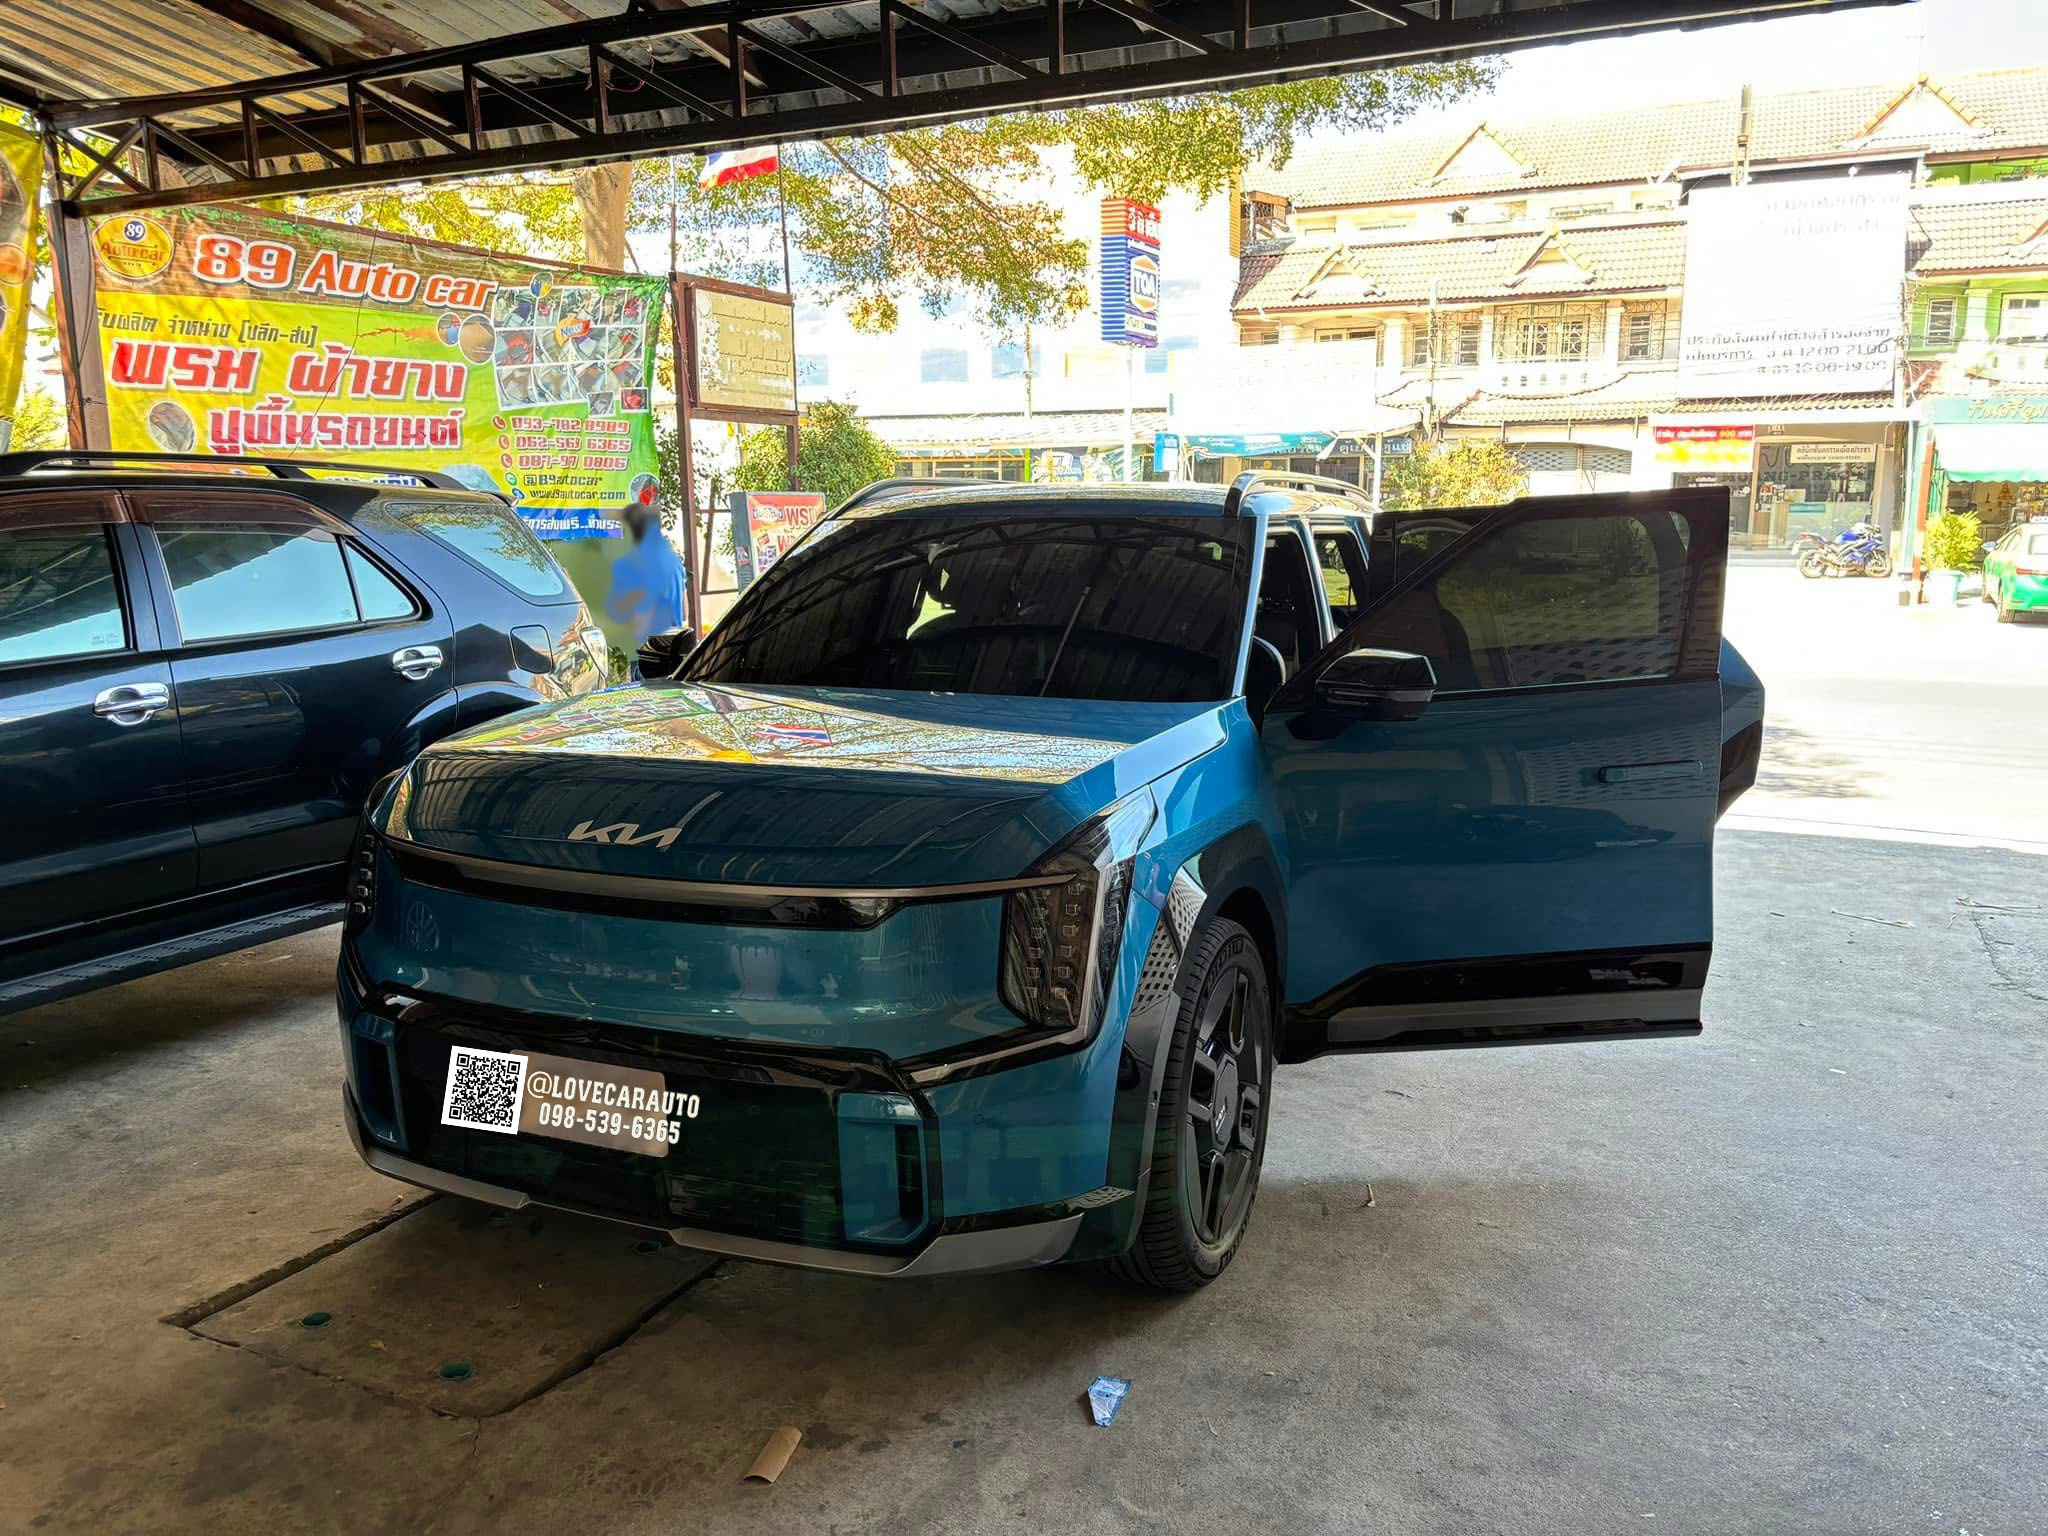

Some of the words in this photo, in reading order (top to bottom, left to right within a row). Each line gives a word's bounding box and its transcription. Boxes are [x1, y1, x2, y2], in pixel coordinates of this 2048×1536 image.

[126, 222, 145, 238] 89
[193, 233, 296, 289] 89
[298, 249, 420, 304] Auto
[423, 273, 499, 312] car
[1133, 270, 1157, 300] TOA
[109, 337, 262, 393] พรม
[287, 341, 468, 401] ผ้ายาง
[208, 396, 465, 456] ปูพื้นรถยนต์
[511, 416, 581, 432] 093-782
[584, 418, 630, 434] 8989
[586, 437, 632, 453] 6365
[567, 819, 683, 848] KIA
